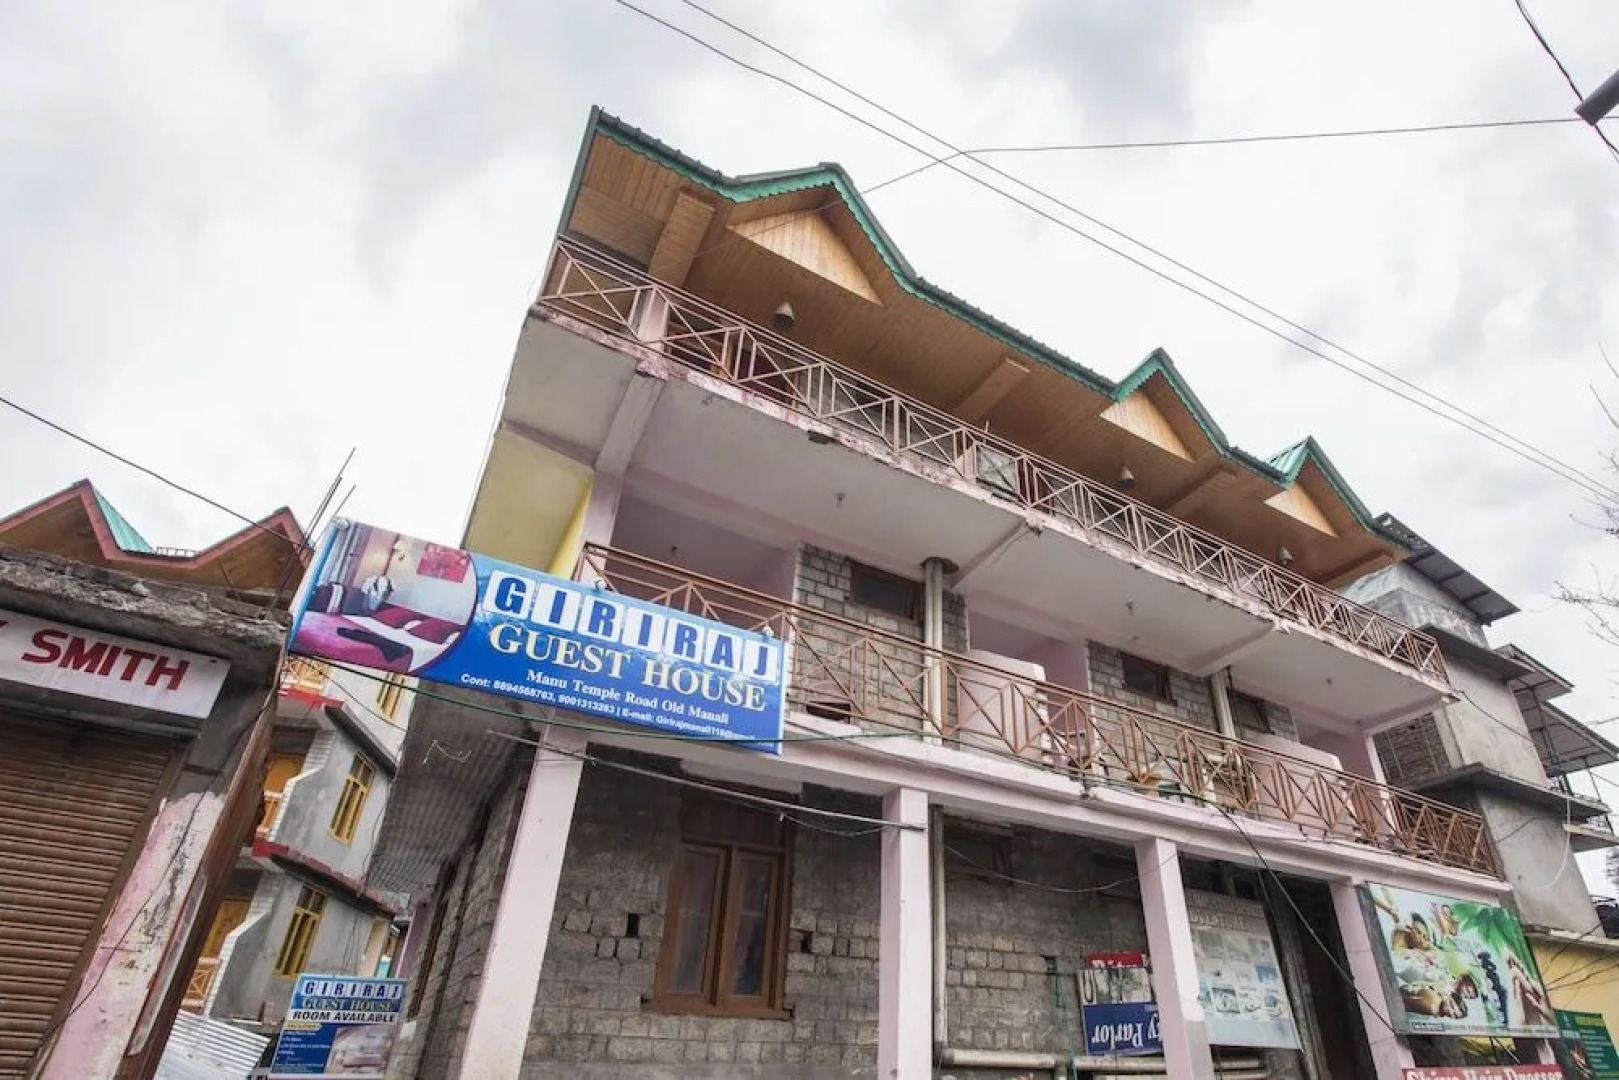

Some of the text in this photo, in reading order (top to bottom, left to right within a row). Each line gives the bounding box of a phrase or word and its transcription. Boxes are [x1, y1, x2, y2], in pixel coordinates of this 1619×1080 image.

[493, 576, 768, 676] GIRIRAJ
[21, 629, 190, 691] SMITH
[461, 673, 490, 687] Cont:
[489, 623, 766, 712] GUEST HOUSE
[526, 669, 729, 725] Manu Temple Road Old Manali
[305, 982, 399, 998] GIRIRAJ
[293, 1011, 395, 1022] ROOM AVAILABLE
[1091, 1022, 1143, 1049] Parlor
